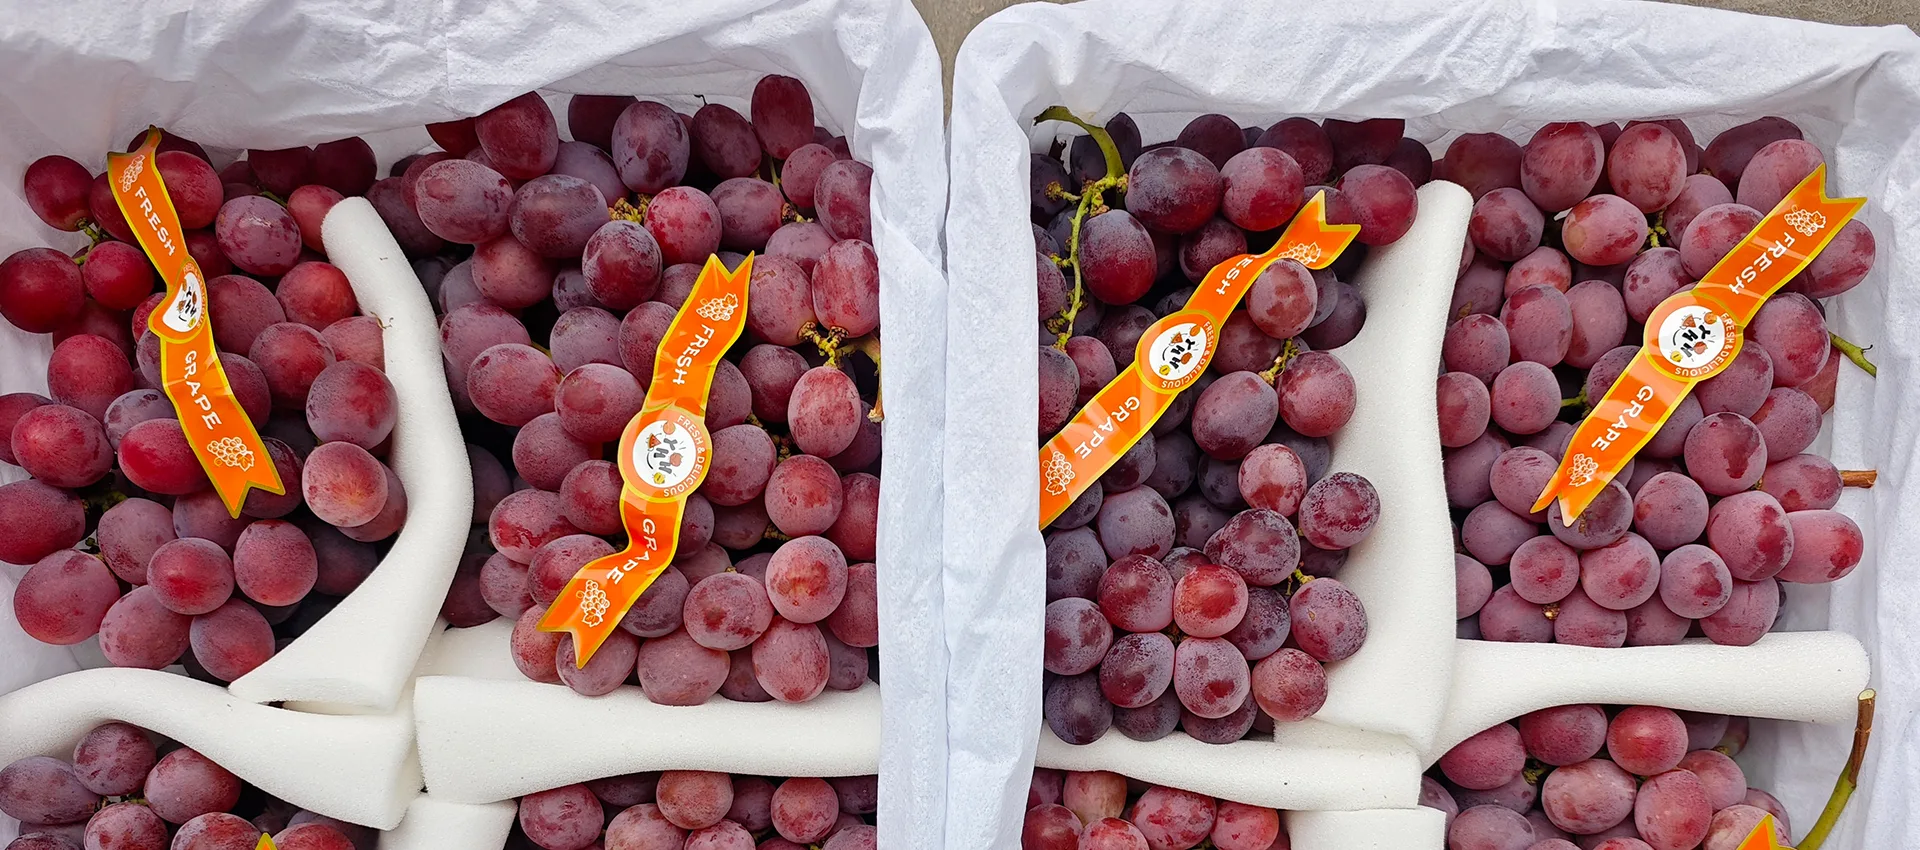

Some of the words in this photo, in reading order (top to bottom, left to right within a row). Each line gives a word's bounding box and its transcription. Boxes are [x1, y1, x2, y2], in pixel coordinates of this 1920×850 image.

[134, 186, 175, 256] FRESH
[1729, 231, 1796, 295] FRESH
[672, 324, 715, 385] FRESH
[1203, 320, 1215, 347] FRESH
[1720, 312, 1735, 343] FRESH
[183, 350, 222, 430] GRAPE
[1161, 358, 1206, 389] DELICIOUS
[1674, 351, 1730, 377] DELICIOUS
[677, 415, 703, 445] FRESH
[1074, 396, 1140, 460] GRAPE
[1591, 385, 1654, 452] GRAPE
[663, 456, 705, 497] DELICIOUS
[606, 518, 657, 585] GRAPE
